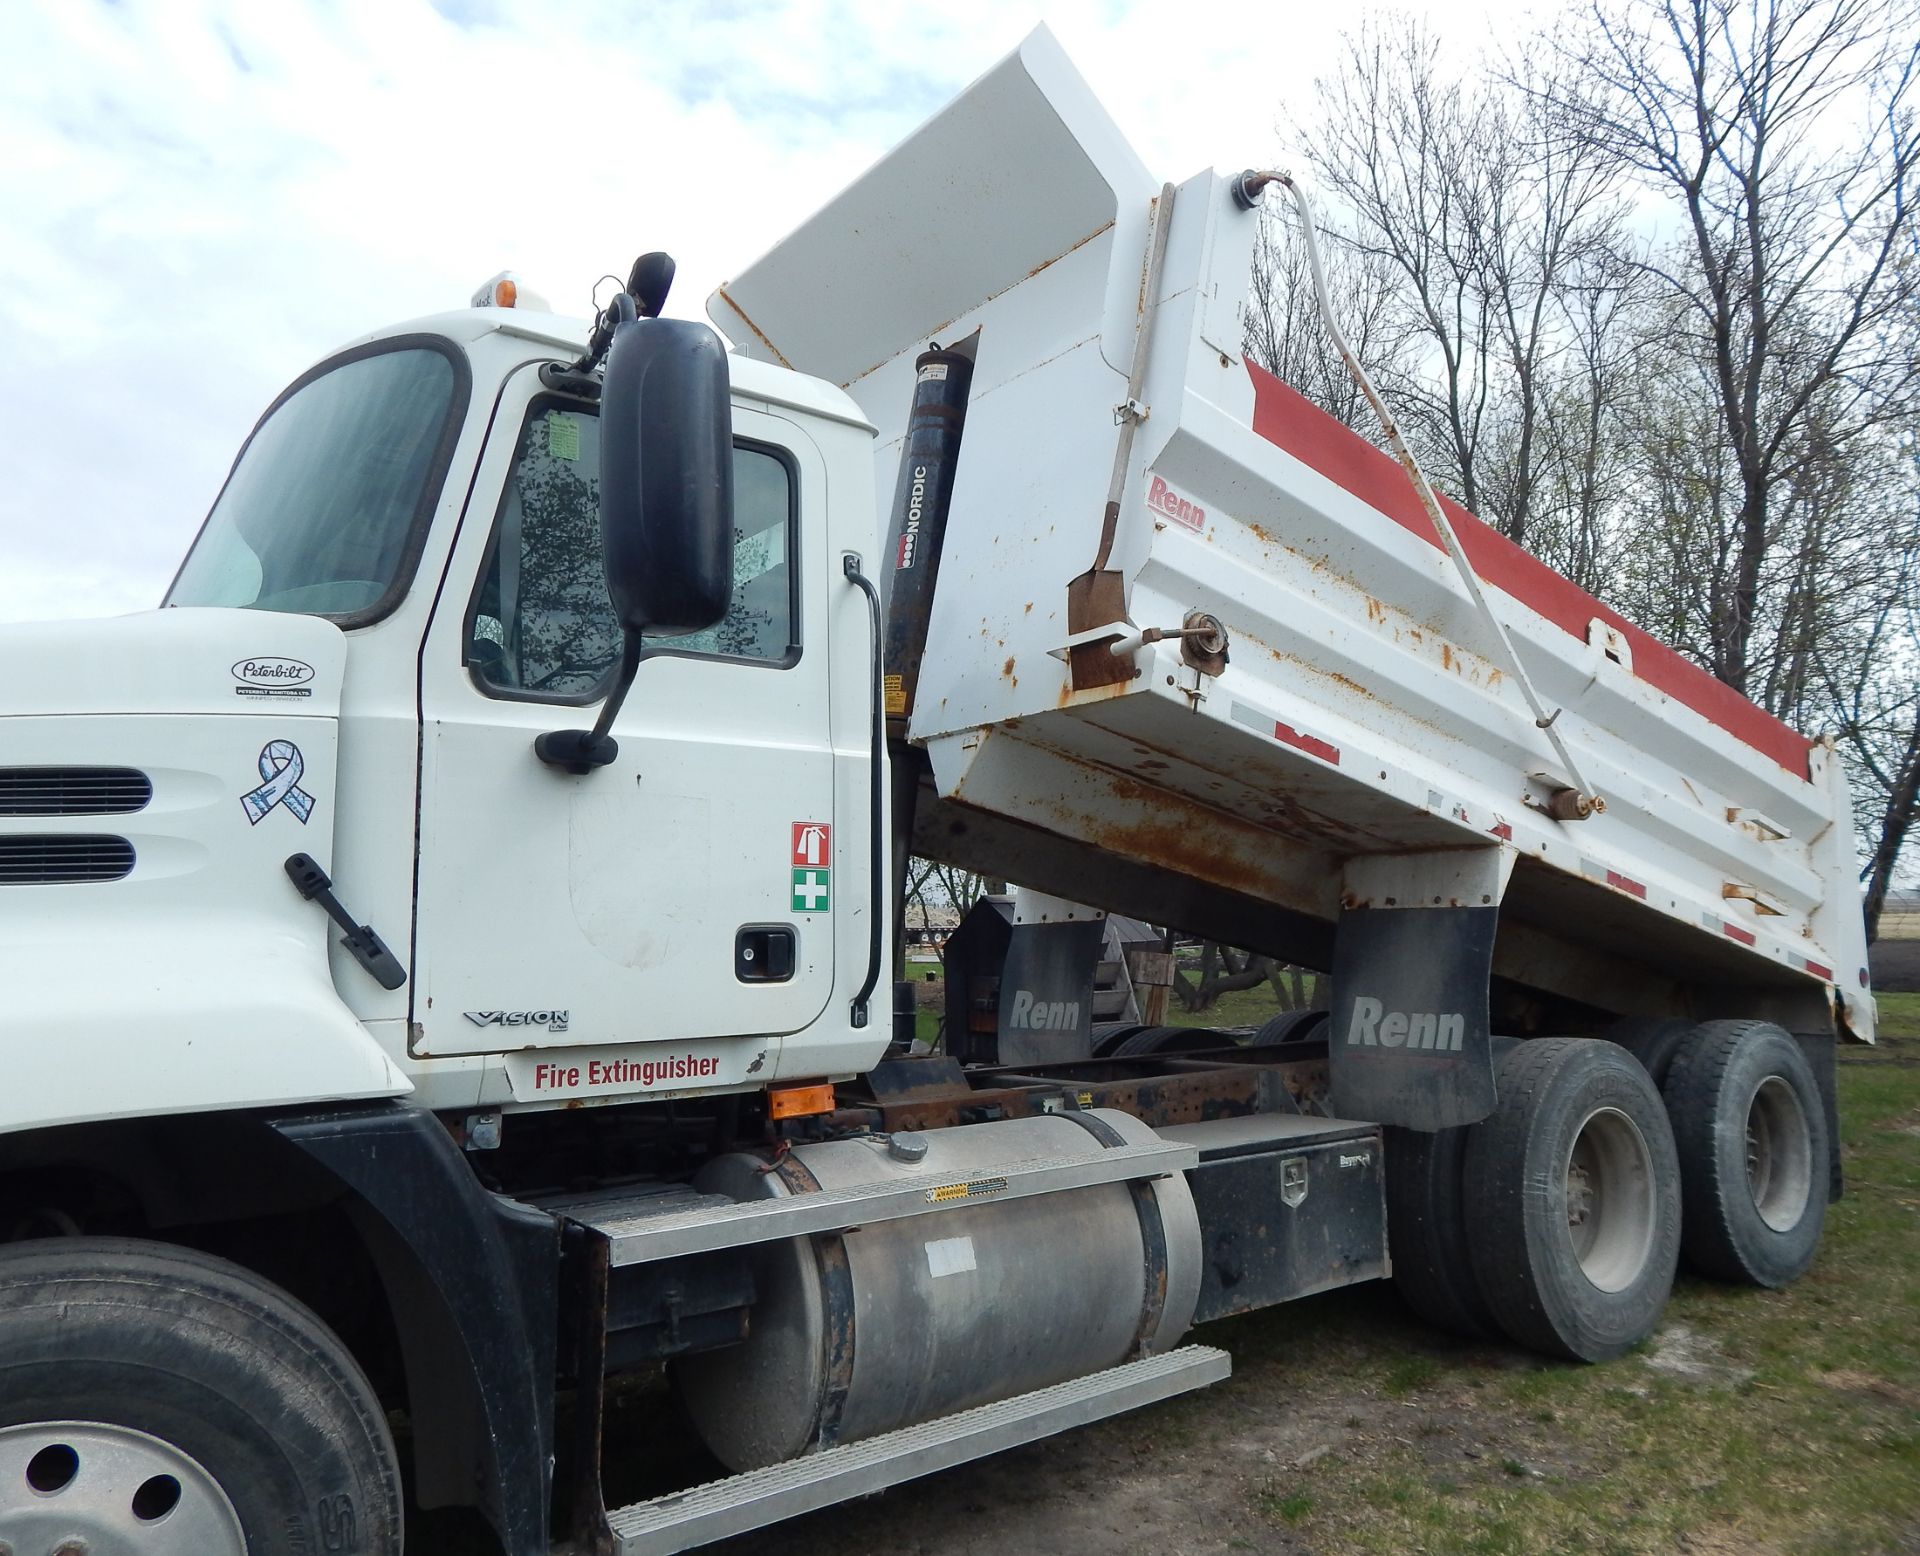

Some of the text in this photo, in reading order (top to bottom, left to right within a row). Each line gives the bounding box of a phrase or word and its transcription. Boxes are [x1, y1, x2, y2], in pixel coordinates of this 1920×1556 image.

[907, 465, 927, 533] NORDIC
[1148, 475, 1205, 528] Renn
[243, 662, 307, 678] Peterbilt
[462, 1010, 569, 1028] VISION
[1009, 990, 1080, 1031] Renn
[1347, 996, 1465, 1051] Renn
[535, 1054, 720, 1090] Fire Extinguisher
[941, 1187, 967, 1198] WARNING
